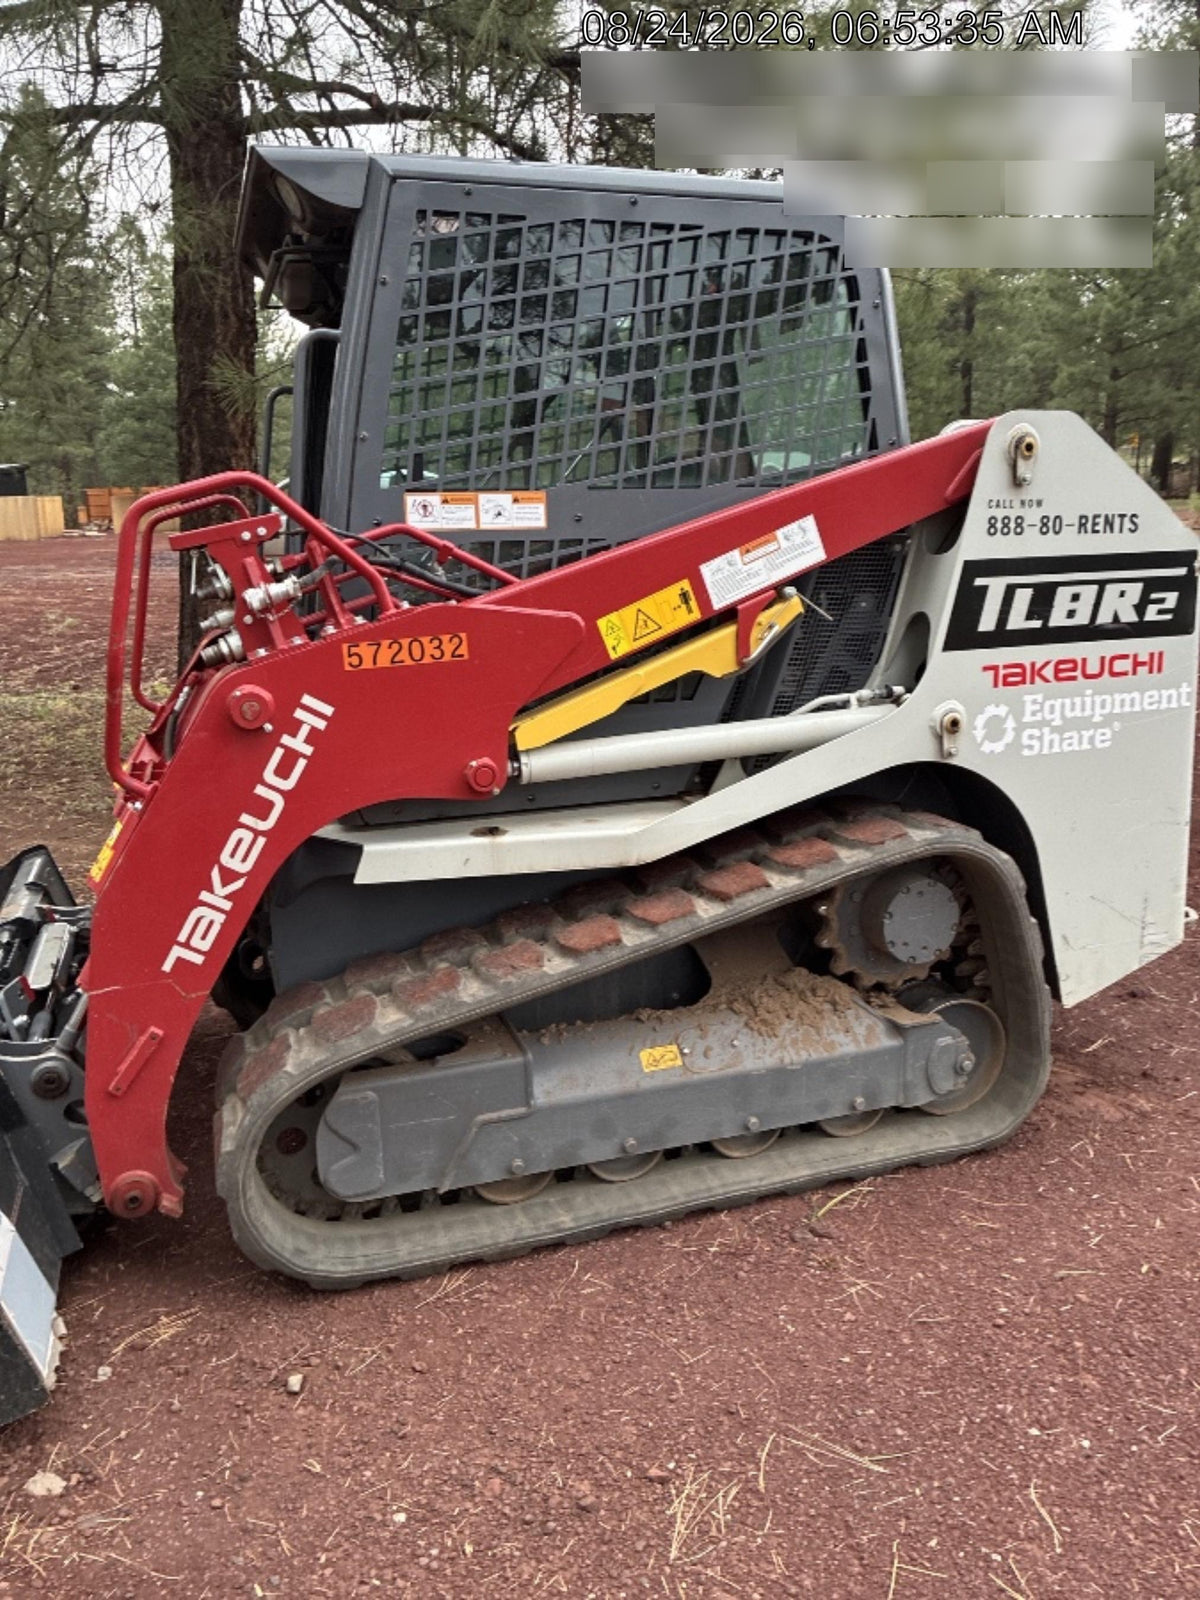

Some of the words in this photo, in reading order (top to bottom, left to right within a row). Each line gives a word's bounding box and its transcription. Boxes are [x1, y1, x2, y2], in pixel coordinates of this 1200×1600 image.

[987, 499, 1014, 509] CALL
[1020, 499, 1043, 509] NOW
[987, 513, 1140, 536] 888-80-RENTS
[973, 567, 1188, 631] TL8R2
[347, 635, 465, 668] 572032
[1022, 682, 1192, 726] Equipment
